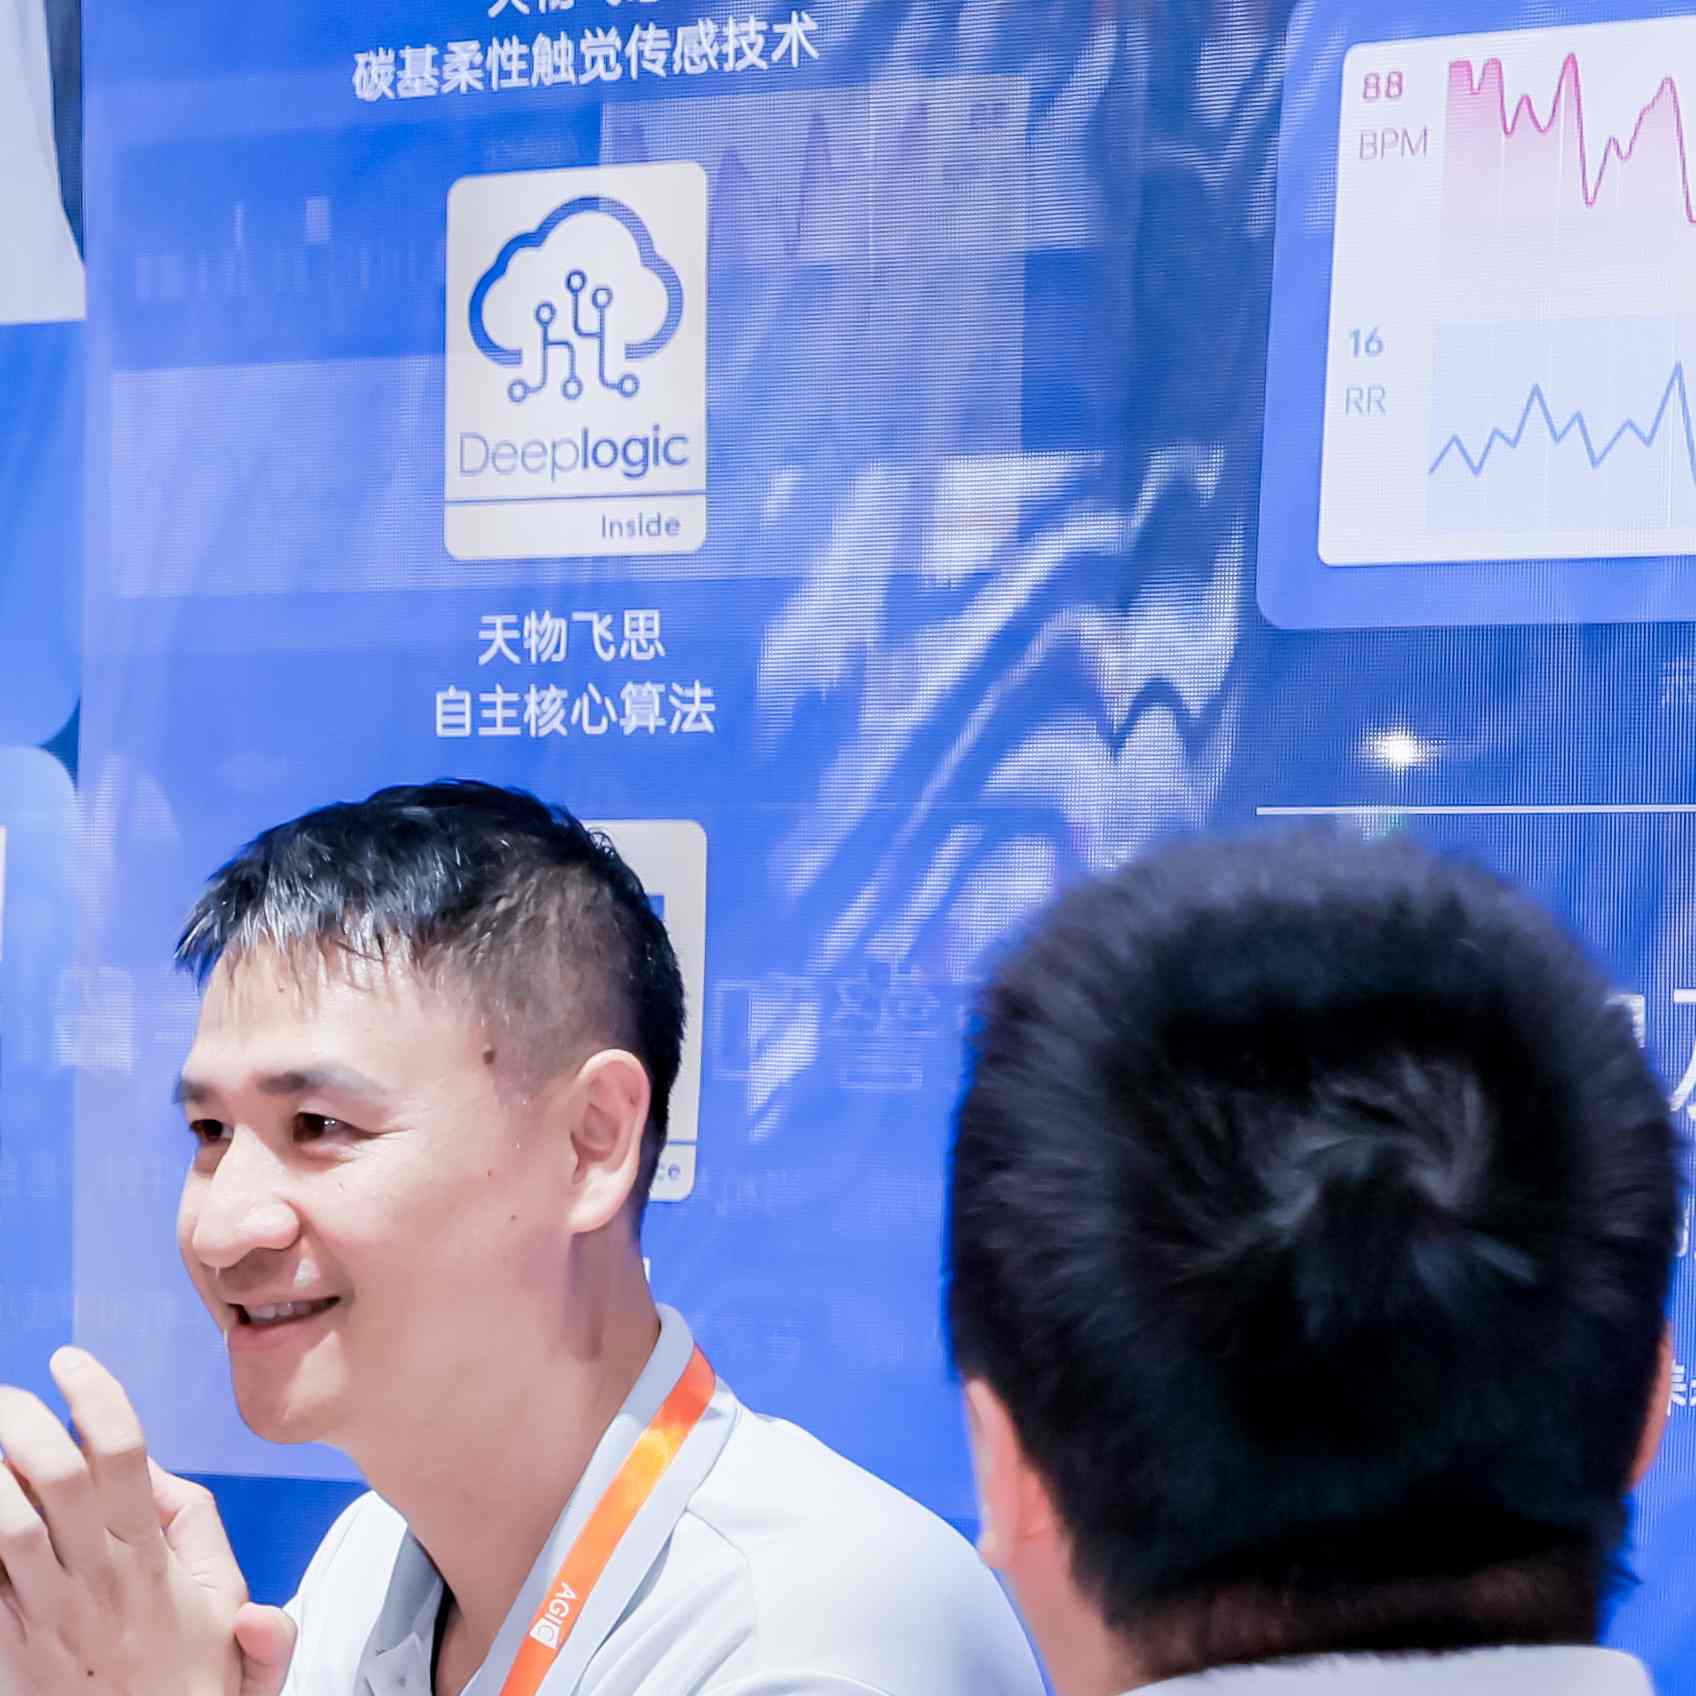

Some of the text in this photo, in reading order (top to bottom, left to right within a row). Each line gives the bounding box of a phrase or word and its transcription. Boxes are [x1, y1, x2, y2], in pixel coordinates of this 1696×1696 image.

[353, 11, 819, 101] 碳基柔性触觉传感技术
[1362, 71, 1404, 101] 88
[1358, 126, 1430, 161] BPM
[1349, 327, 1384, 358] 16
[1344, 386, 1387, 416] RR
[458, 425, 690, 482] Deeplogic
[600, 511, 681, 540] Inside
[477, 608, 666, 665] 天物飞思
[434, 681, 716, 738] 自主核心算法
